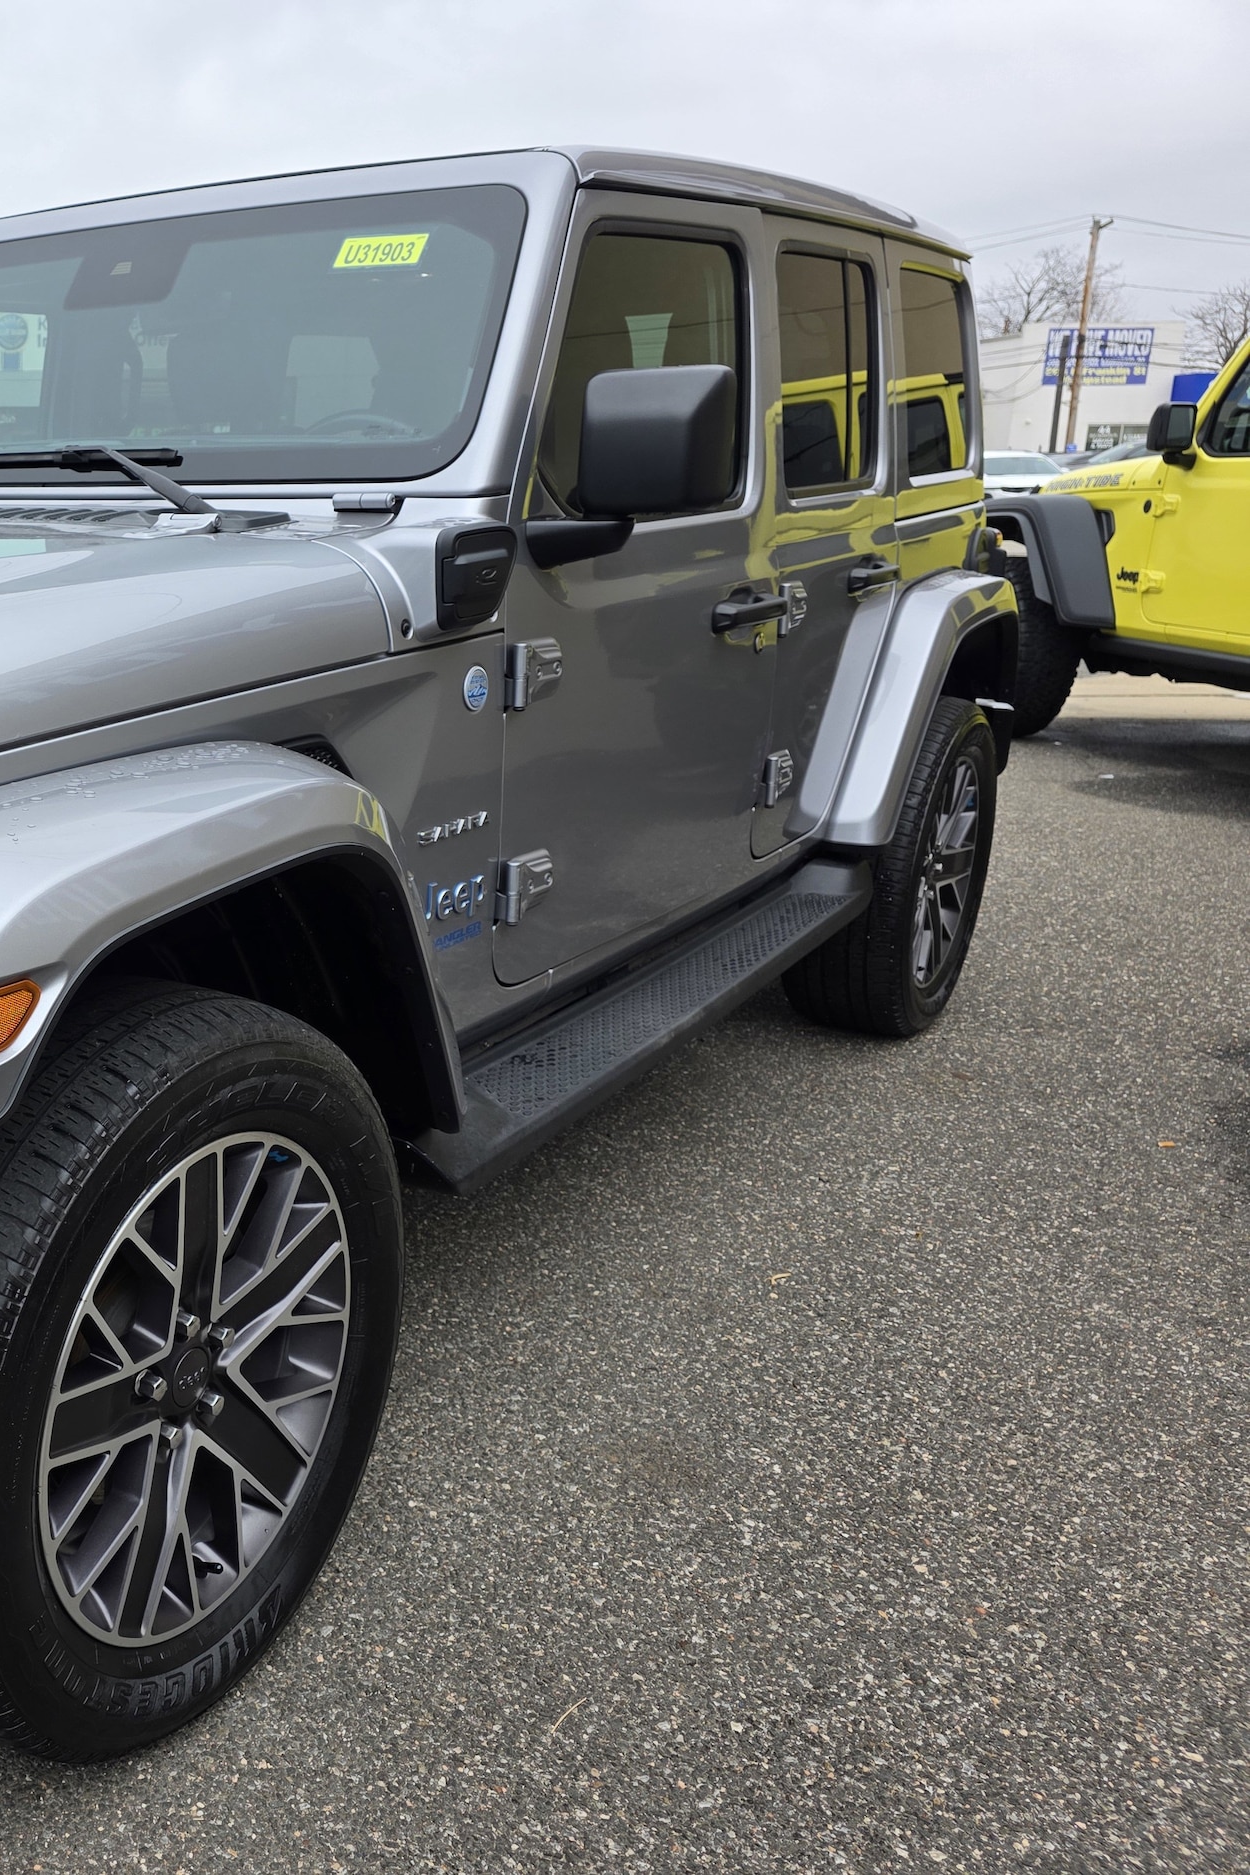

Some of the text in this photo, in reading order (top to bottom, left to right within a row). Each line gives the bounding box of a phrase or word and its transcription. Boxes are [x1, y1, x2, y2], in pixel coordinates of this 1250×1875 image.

[344, 242, 416, 265] U31903
[1106, 329, 1153, 356] MOVED
[1116, 566, 1139, 585] Jeep
[417, 811, 490, 845] SAHARA
[425, 875, 486, 920] Jeep
